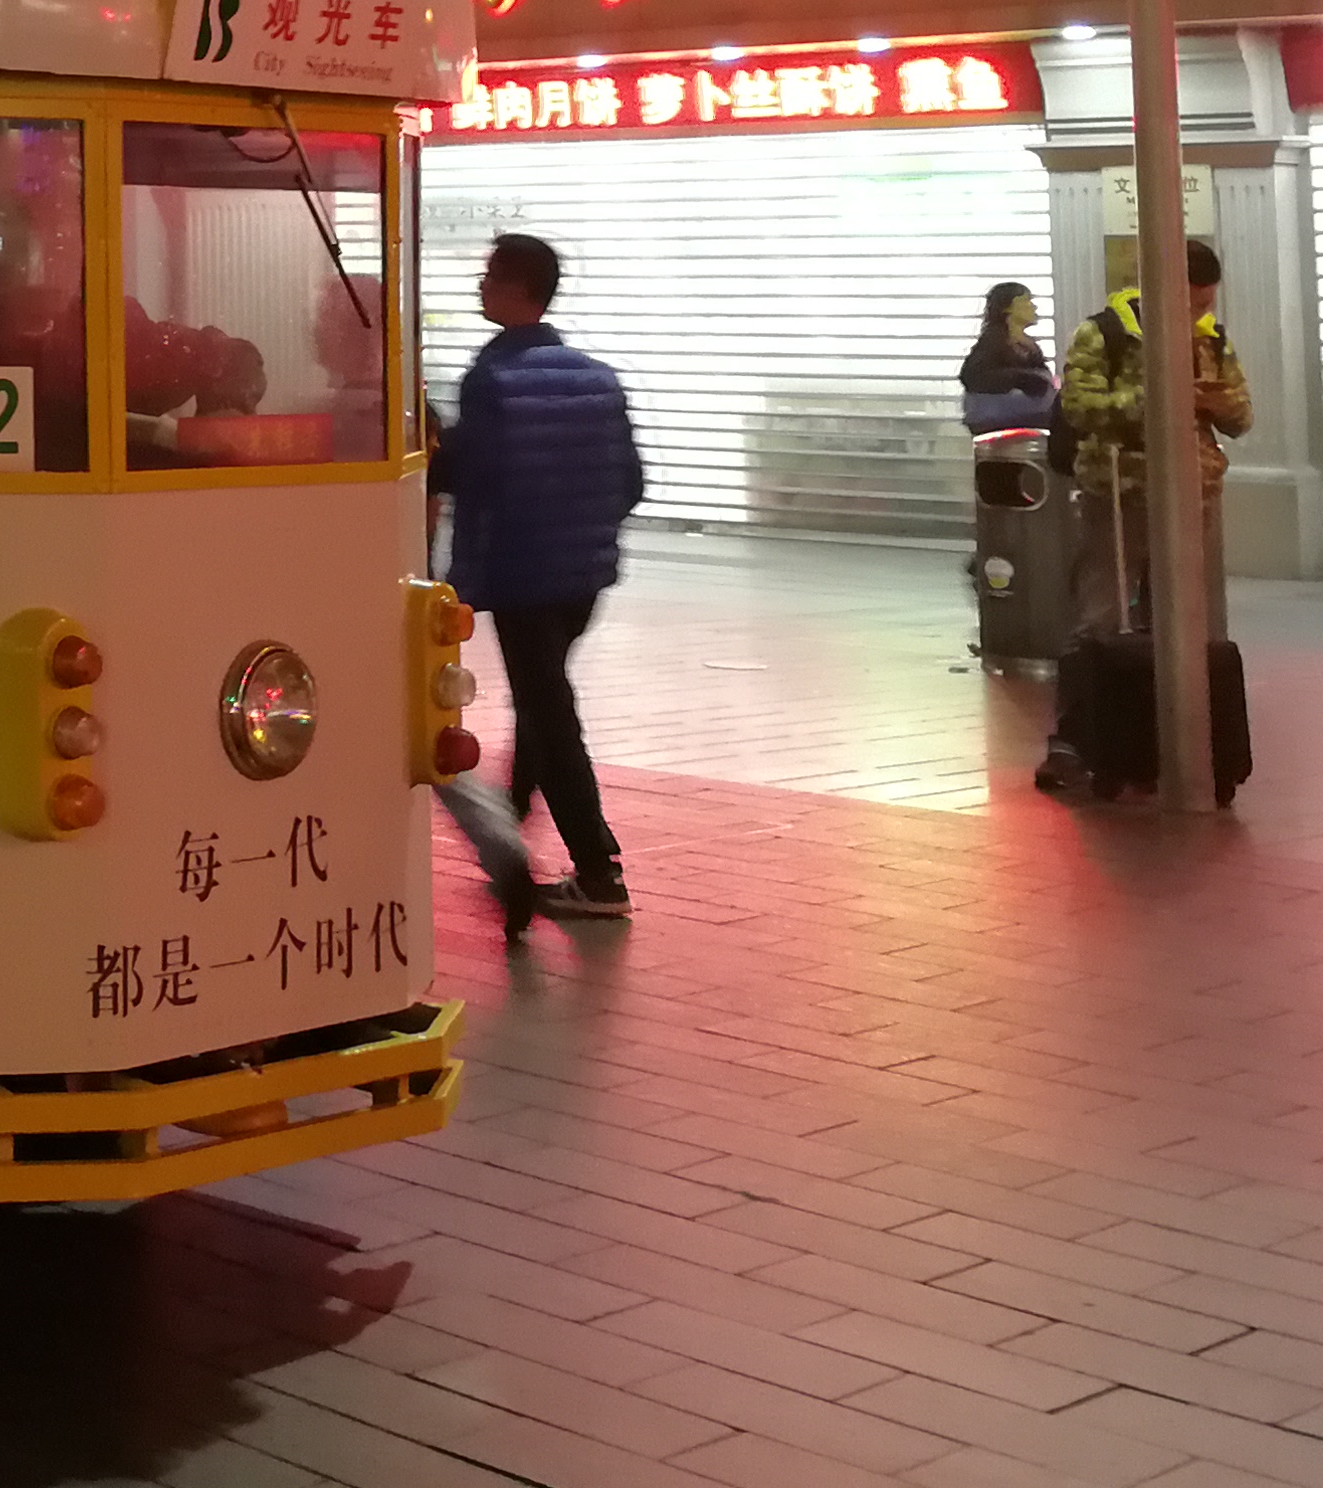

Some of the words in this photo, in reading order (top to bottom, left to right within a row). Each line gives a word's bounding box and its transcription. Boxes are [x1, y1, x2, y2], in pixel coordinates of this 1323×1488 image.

[253, 50, 285, 76] City
[1114, 177, 1200, 194] 文位
[175, 814, 330, 903] 每一代
[86, 900, 409, 1019] 都是一个时代
